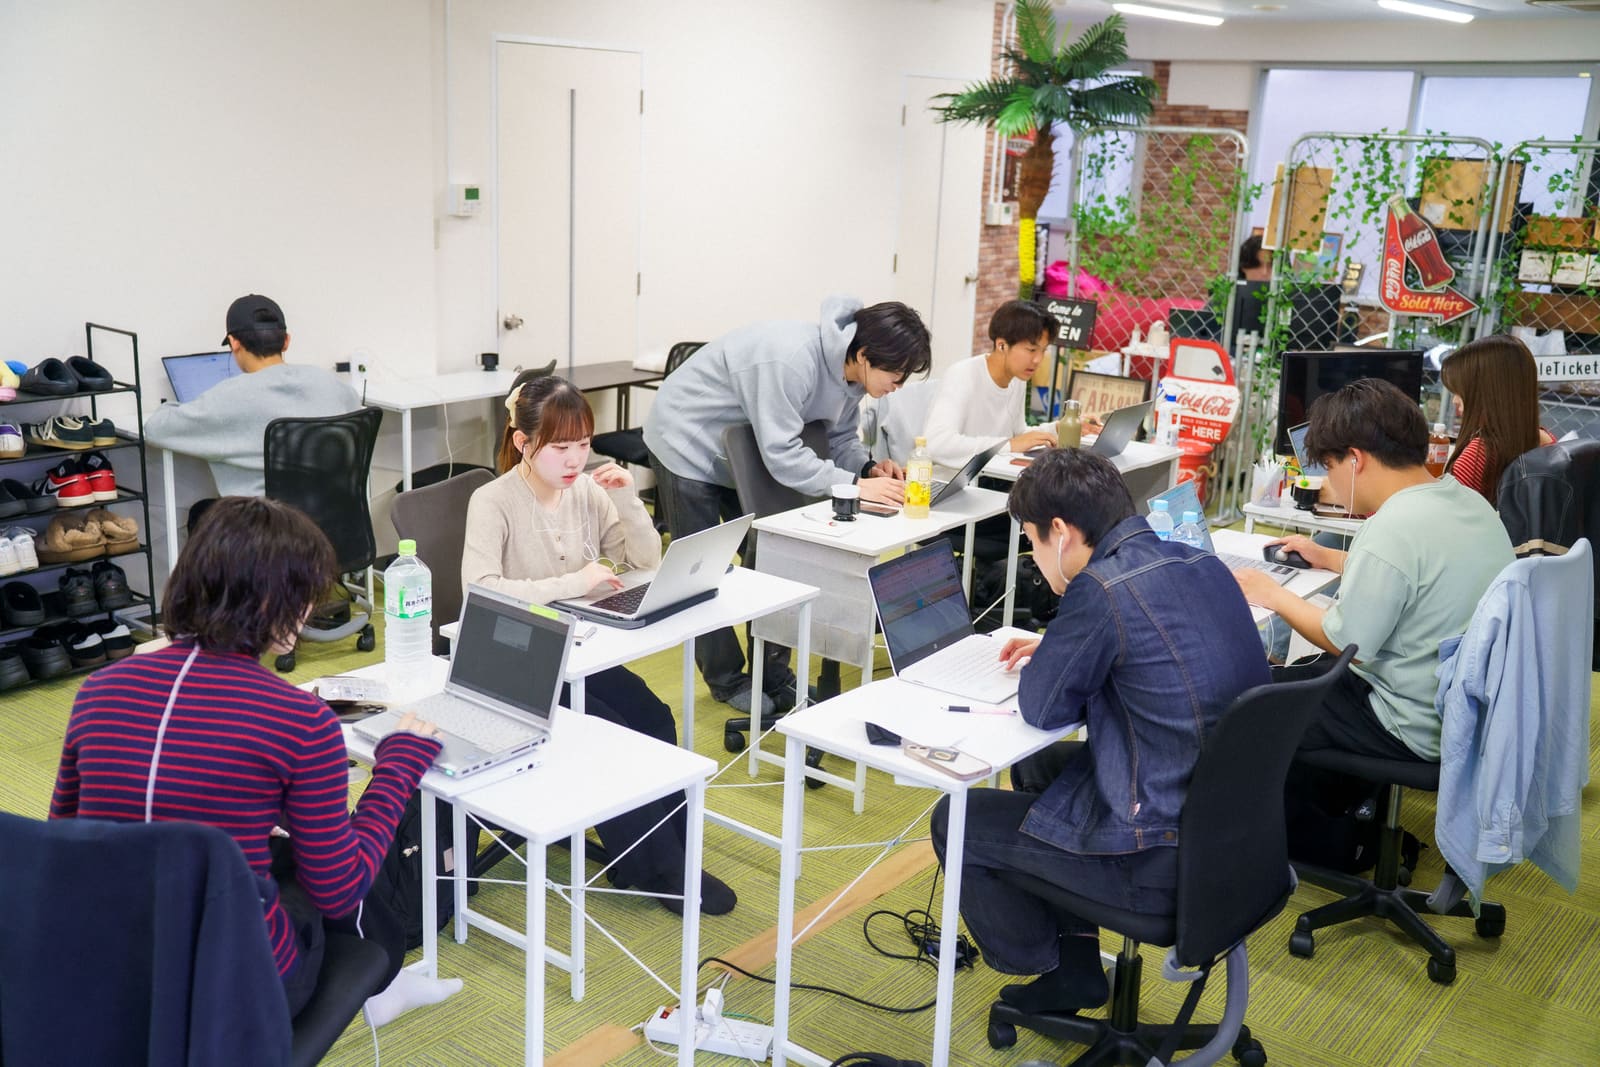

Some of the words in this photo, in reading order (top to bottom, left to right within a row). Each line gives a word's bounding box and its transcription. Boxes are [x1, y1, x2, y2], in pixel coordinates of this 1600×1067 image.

[1047, 301, 1072, 316] Come
[1400, 295, 1430, 310] Sold
[1432, 296, 1464, 311] Here
[1058, 325, 1082, 342] EN
[1191, 425, 1222, 441] HERE
